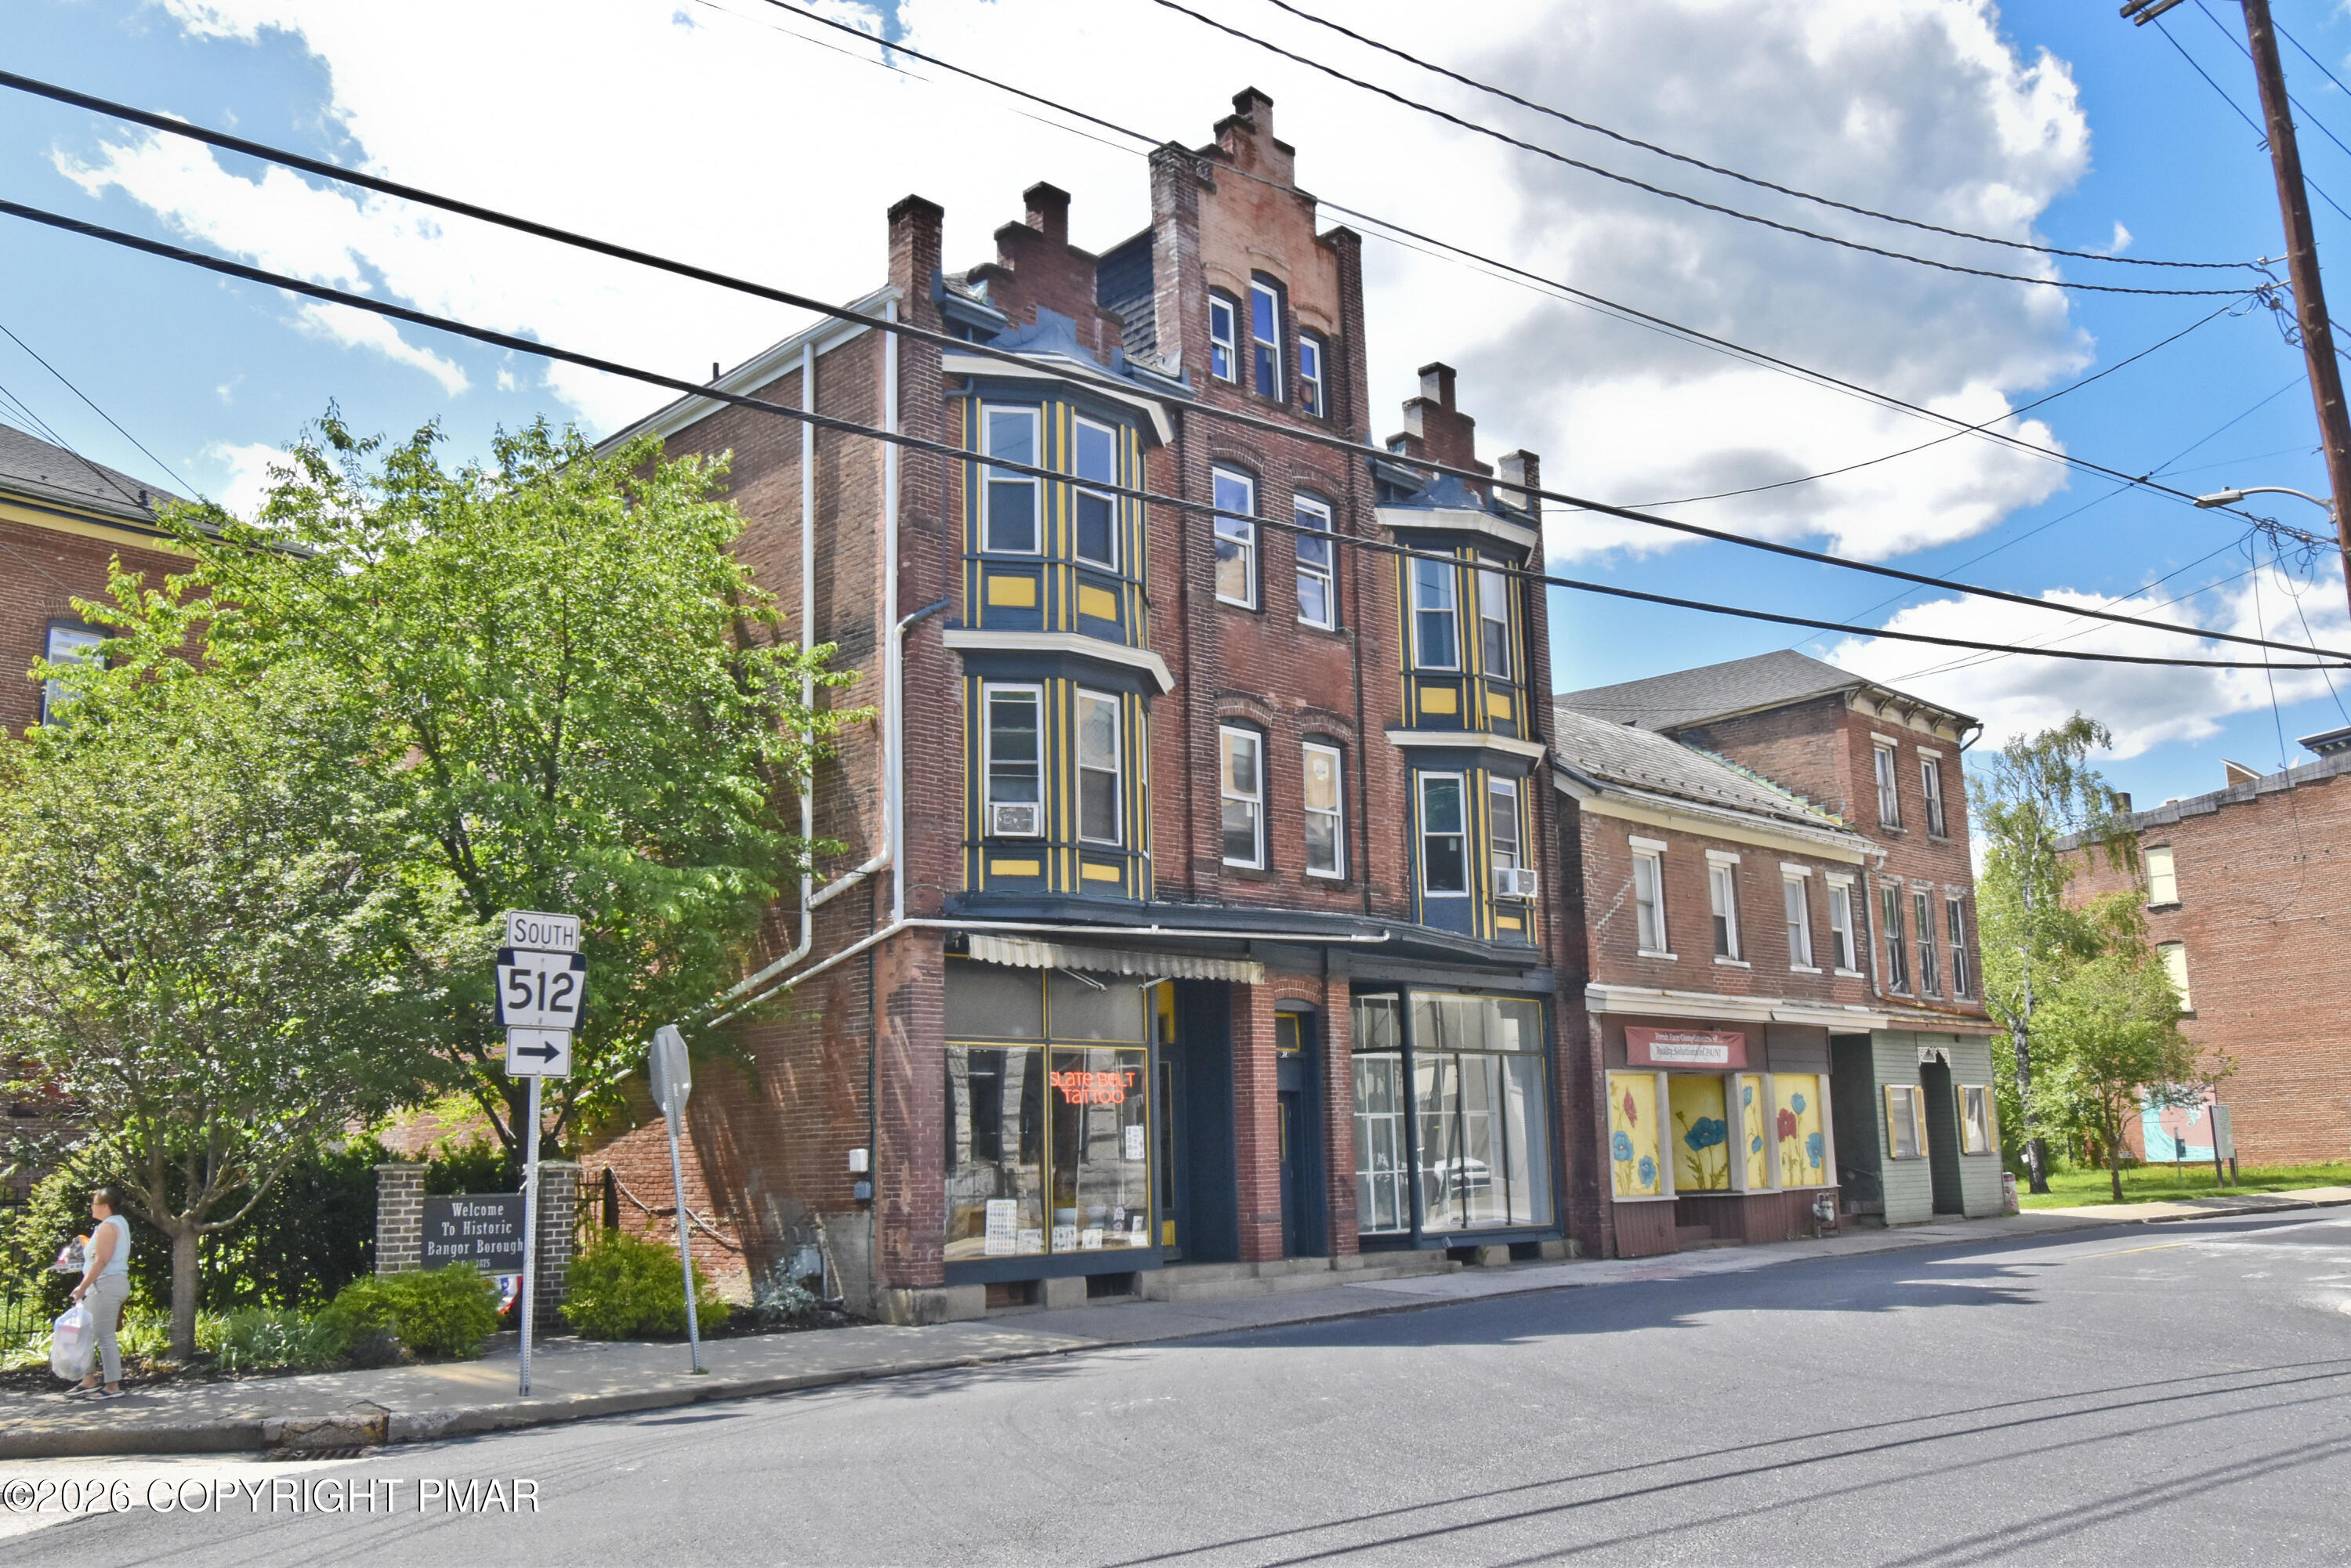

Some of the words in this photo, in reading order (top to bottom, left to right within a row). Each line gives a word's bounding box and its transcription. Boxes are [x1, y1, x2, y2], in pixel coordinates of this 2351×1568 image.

[514, 918, 574, 946] SOUTH
[508, 969, 574, 1012] 512
[451, 1202, 504, 1217] Welcome
[441, 1222, 455, 1237] To
[463, 1219, 513, 1235] Historic
[427, 1241, 470, 1258] Bangor
[476, 1237, 523, 1255] Borough
[476, 1258, 491, 1268] 1875
